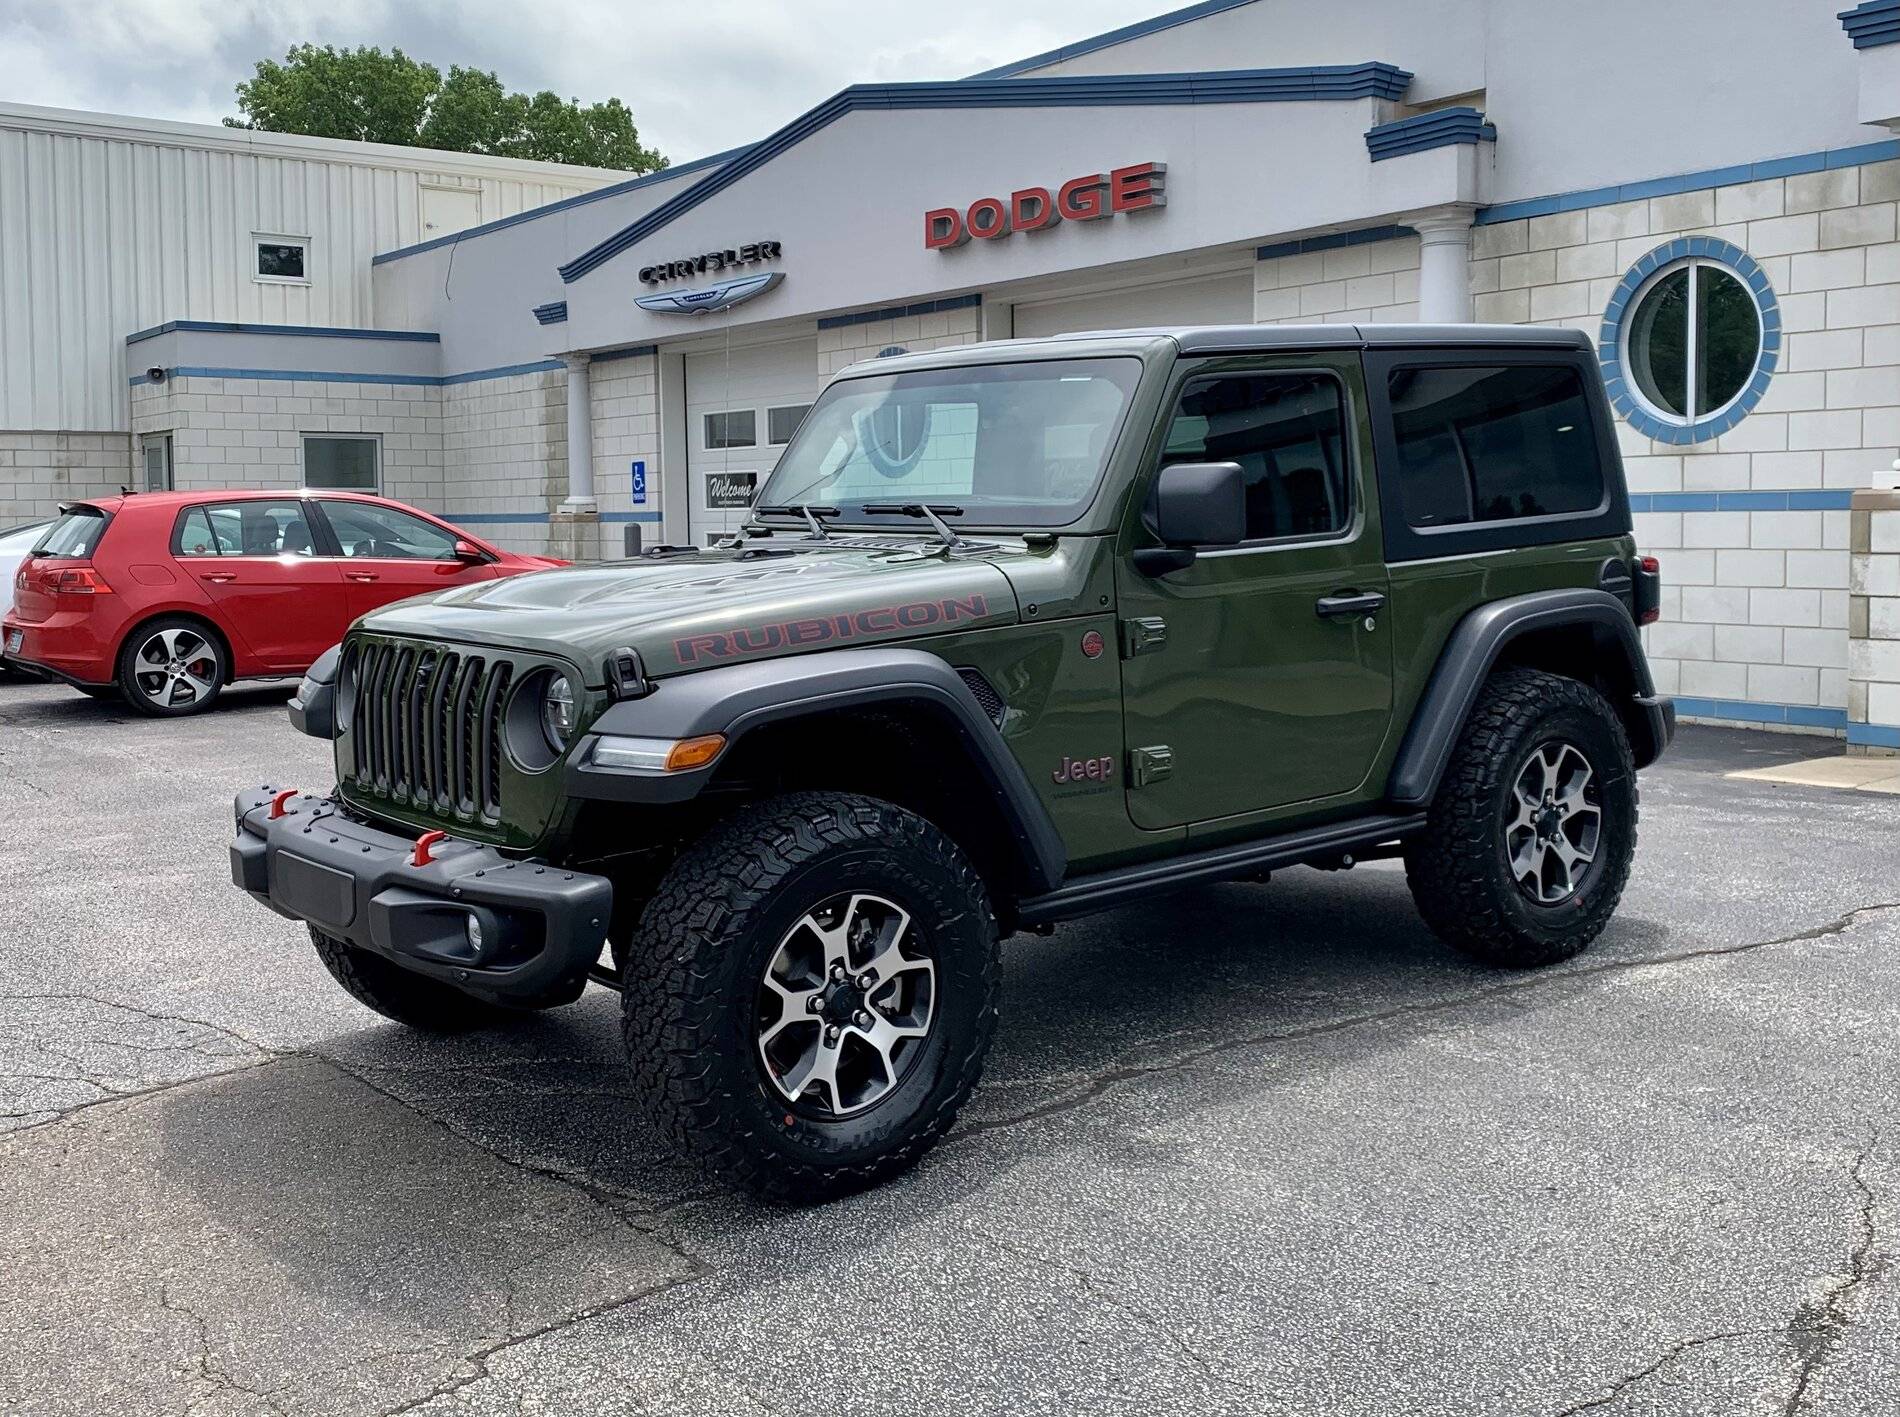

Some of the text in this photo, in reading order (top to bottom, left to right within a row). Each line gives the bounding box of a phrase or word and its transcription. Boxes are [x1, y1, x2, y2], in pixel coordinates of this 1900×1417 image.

[925, 162, 1167, 249] DODGE
[638, 240, 781, 284] CHRYSLER
[710, 477, 752, 497] Welcome
[672, 592, 990, 664] RUBICON
[1052, 756, 1115, 784] Jeep
